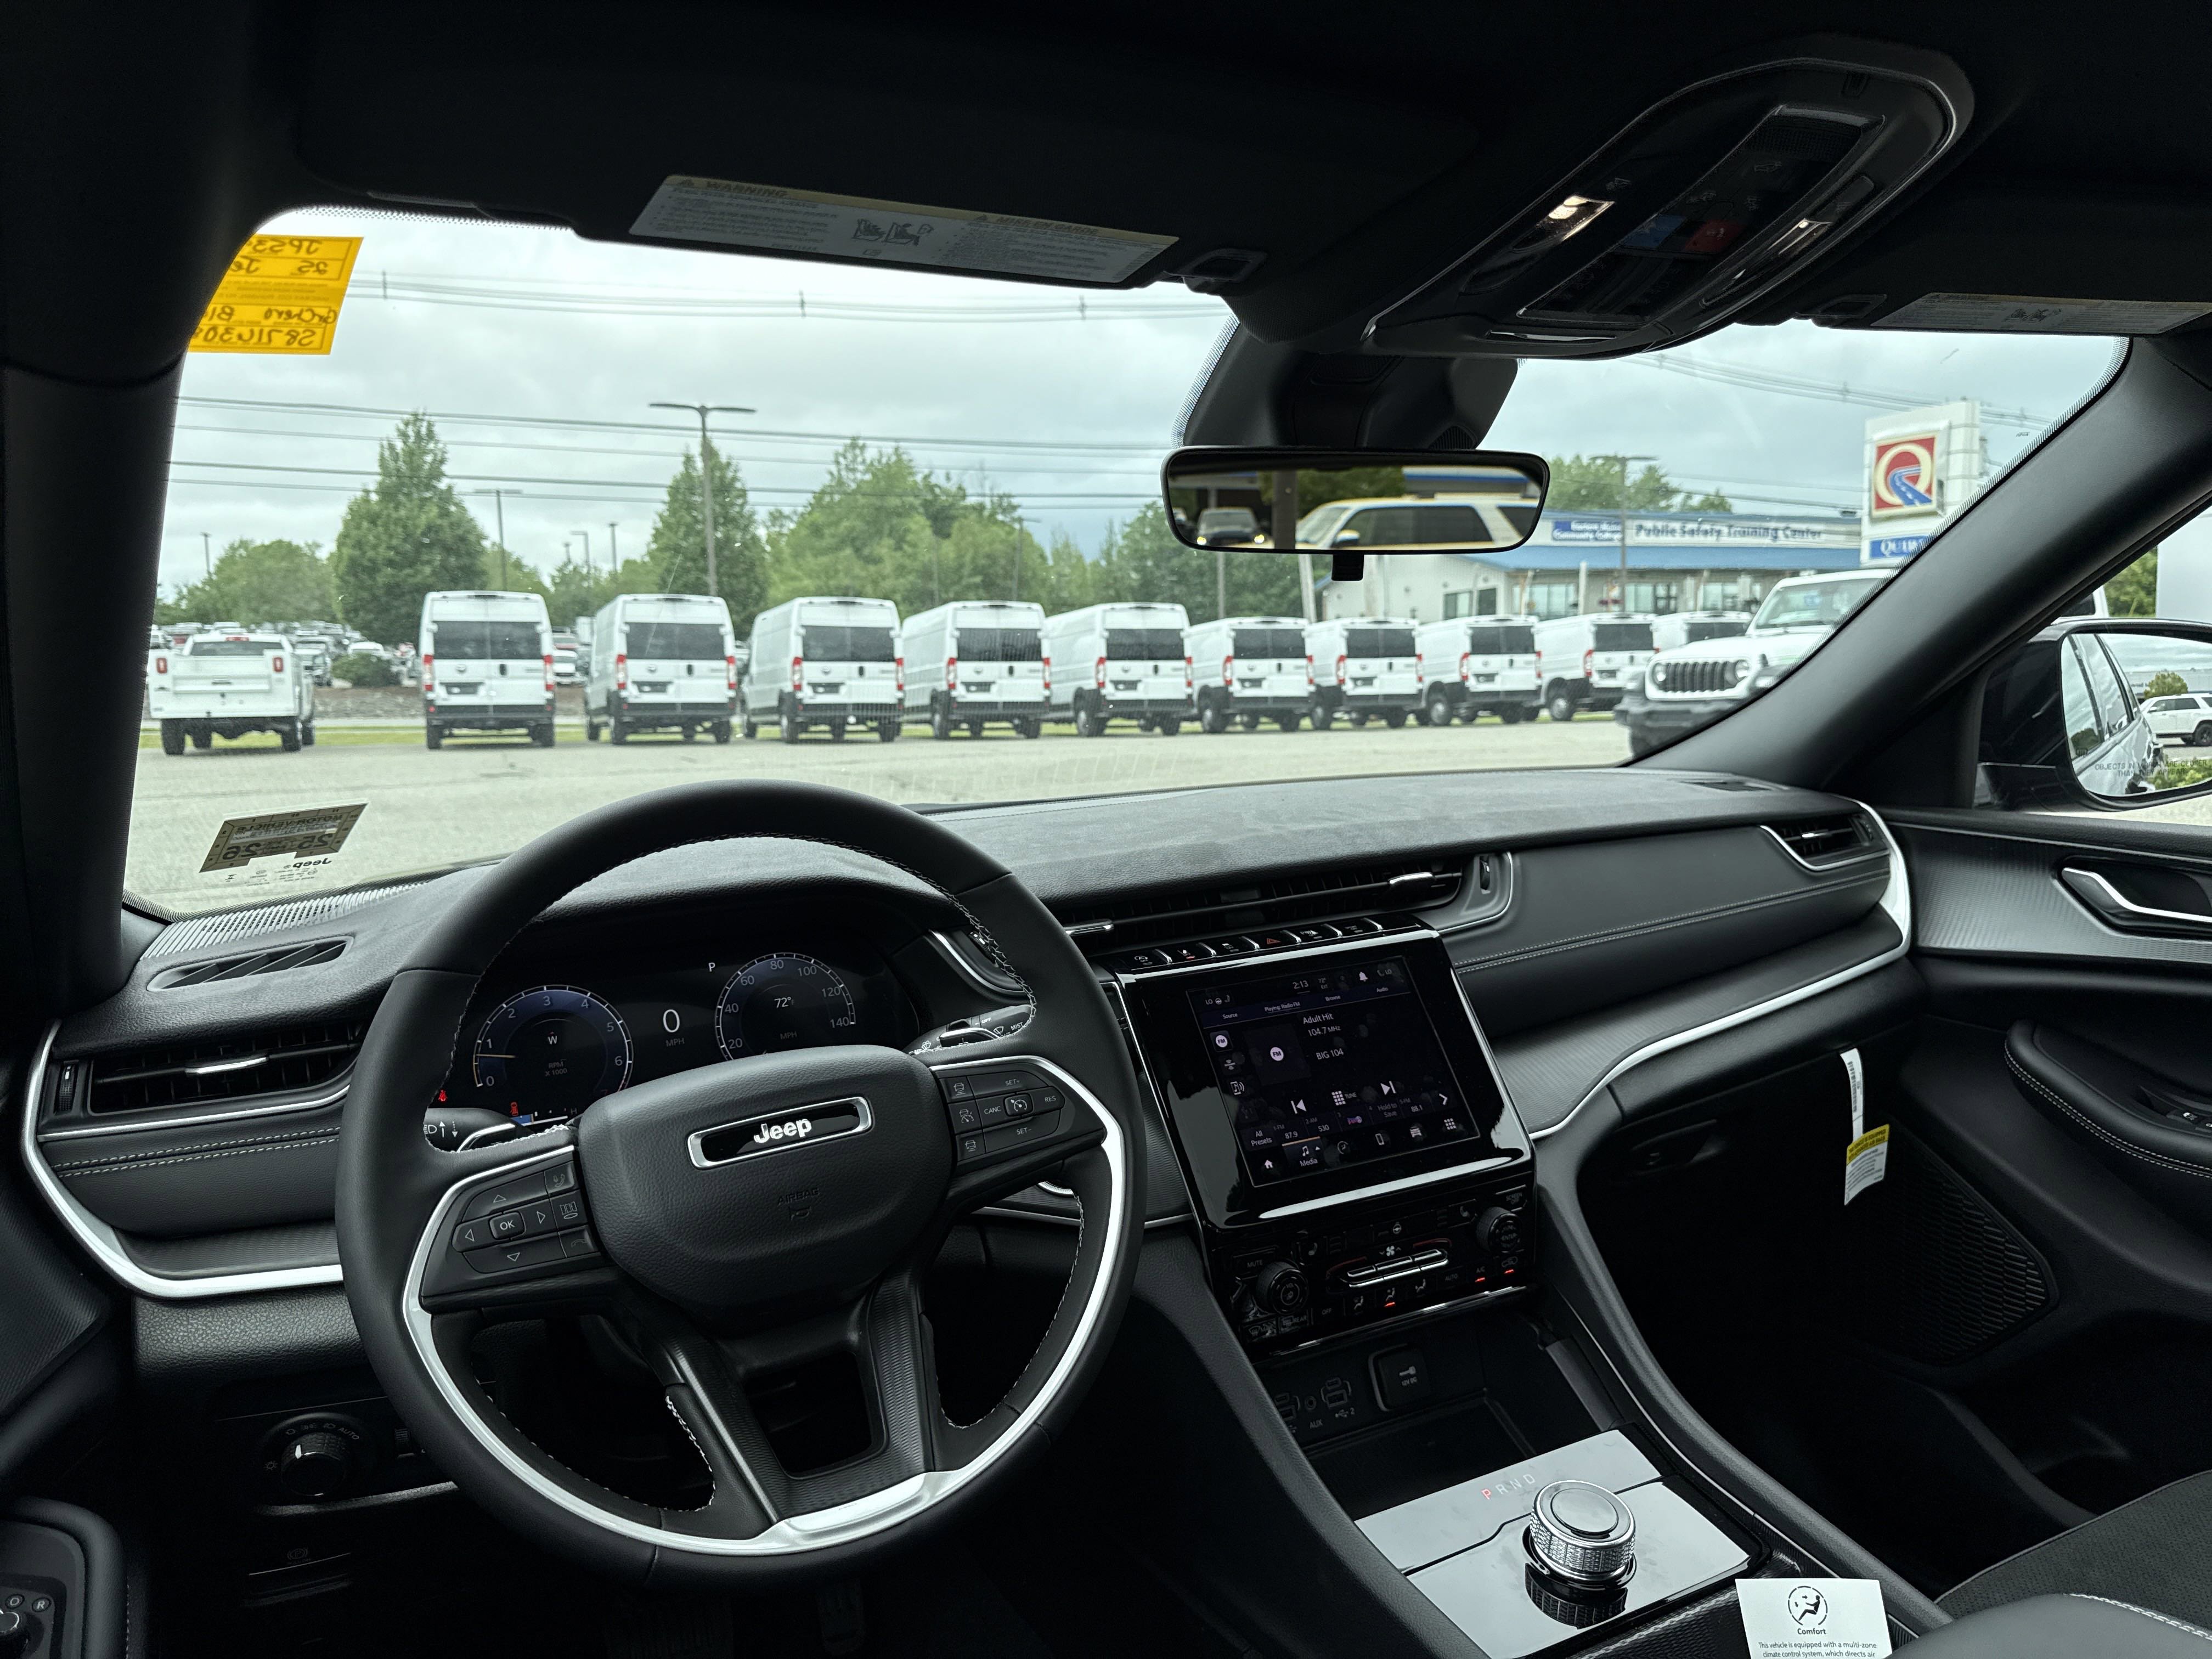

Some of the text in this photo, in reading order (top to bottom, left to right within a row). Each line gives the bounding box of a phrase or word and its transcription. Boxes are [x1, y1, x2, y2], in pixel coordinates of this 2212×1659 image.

[704, 180, 788, 199] WARNING
[1635, 523, 1822, 541] Public Safety Training Center
[2094, 762, 2126, 770] OBJECTS
[708, 962, 715, 973] P
[770, 960, 785, 970] 80
[798, 966, 818, 977] 100
[740, 975, 755, 986] 60
[1292, 980, 1309, 989] 2:13
[822, 986, 842, 998] 120
[544, 996, 552, 1006] 3
[580, 999, 590, 1008] 4
[507, 1008, 516, 1019] 2
[725, 1003, 740, 1014] 40
[662, 1009, 681, 1034] 0
[830, 1017, 850, 1029] 140
[1303, 1013, 1334, 1025] Adult Hit
[607, 1022, 614, 1032] 5
[1010, 1022, 1024, 1031] MIST
[1307, 1026, 1328, 1037] 104.7
[548, 1035, 558, 1045] W
[780, 1031, 798, 1041] MPH
[487, 1039, 493, 1049] 1
[665, 1037, 685, 1047] MPH
[728, 1037, 743, 1049] 20
[1316, 1048, 1345, 1060] BIG 104
[614, 1056, 623, 1066] 6
[551, 1068, 568, 1076] 1000
[486, 1075, 495, 1087] 0
[984, 1105, 1002, 1115] CANC
[1410, 1104, 1423, 1113] 88.1
[753, 1117, 812, 1144] Jeep
[1284, 1131, 1299, 1139] 87.9
[1250, 1137, 1273, 1147] Presets
[1299, 1158, 1318, 1167] Media
[777, 1187, 821, 1206] AIRBAG
[500, 1220, 515, 1231] OK
[1247, 1260, 1263, 1268] MUTE
[1444, 1273, 1458, 1282] AUTO
[1310, 1419, 1324, 1429] AUX
[338, 1426, 360, 1440] AUTO
[1481, 1474, 1536, 1500] P R N D
[1793, 1641, 1821, 1651] equipped
